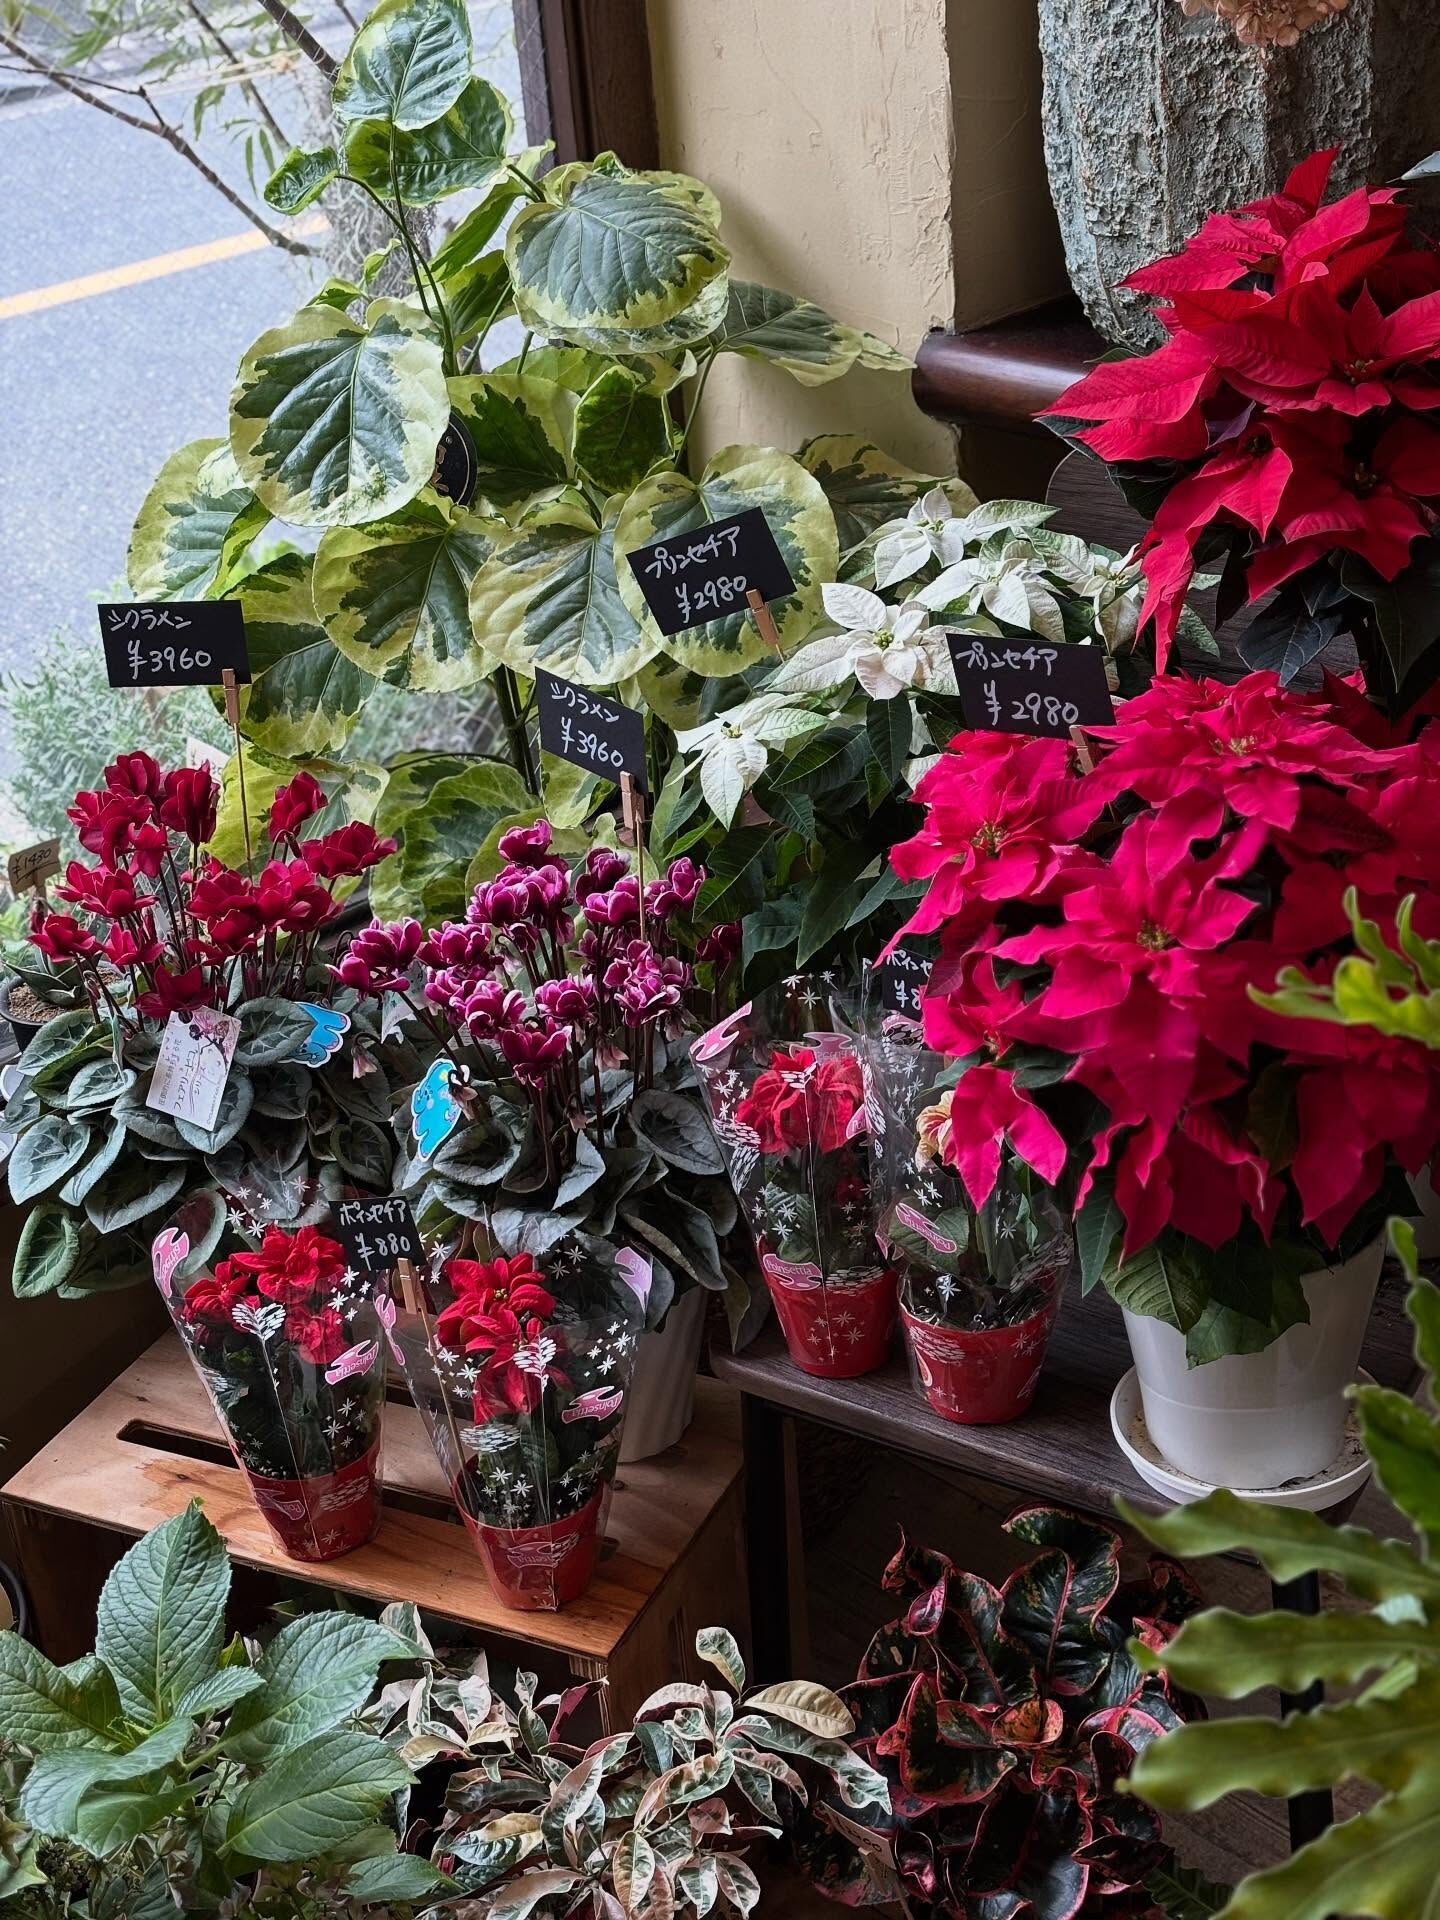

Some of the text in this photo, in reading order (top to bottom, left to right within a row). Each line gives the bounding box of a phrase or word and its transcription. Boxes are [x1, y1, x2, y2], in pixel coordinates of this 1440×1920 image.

[675, 575, 748, 624] ¥2980
[108, 609, 192, 632] シクラメン
[127, 639, 212, 680] ¥3960
[550, 682, 620, 723] シクラメン
[983, 679, 1079, 727] ¥2980
[561, 716, 624, 768] ¥3960
[340, 1199, 406, 1226] ポインセチア
[354, 1232, 411, 1271] ¥880
